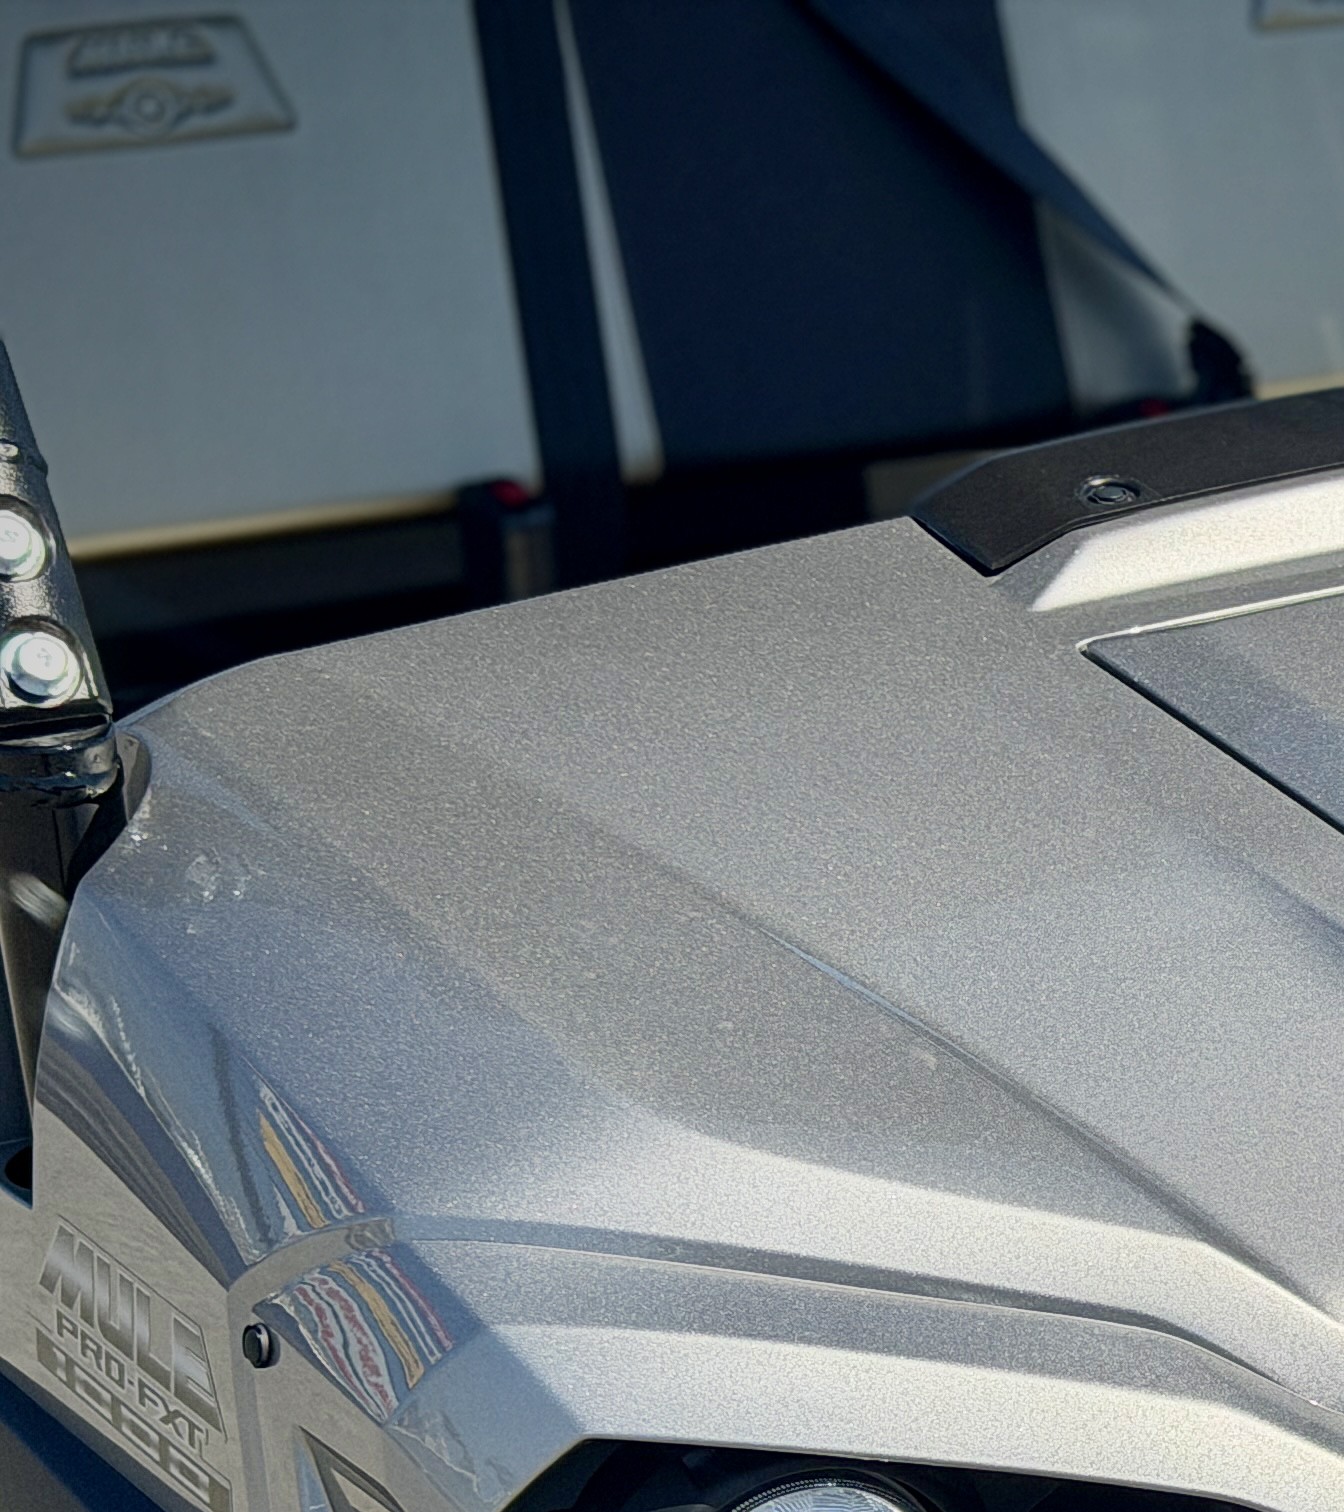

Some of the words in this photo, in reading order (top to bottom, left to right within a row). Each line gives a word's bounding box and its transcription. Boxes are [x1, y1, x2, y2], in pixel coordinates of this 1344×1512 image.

[38, 1224, 222, 1434] MULE
[56, 1309, 204, 1449] PRO-FXT
[52, 1347, 210, 1504] 1000
